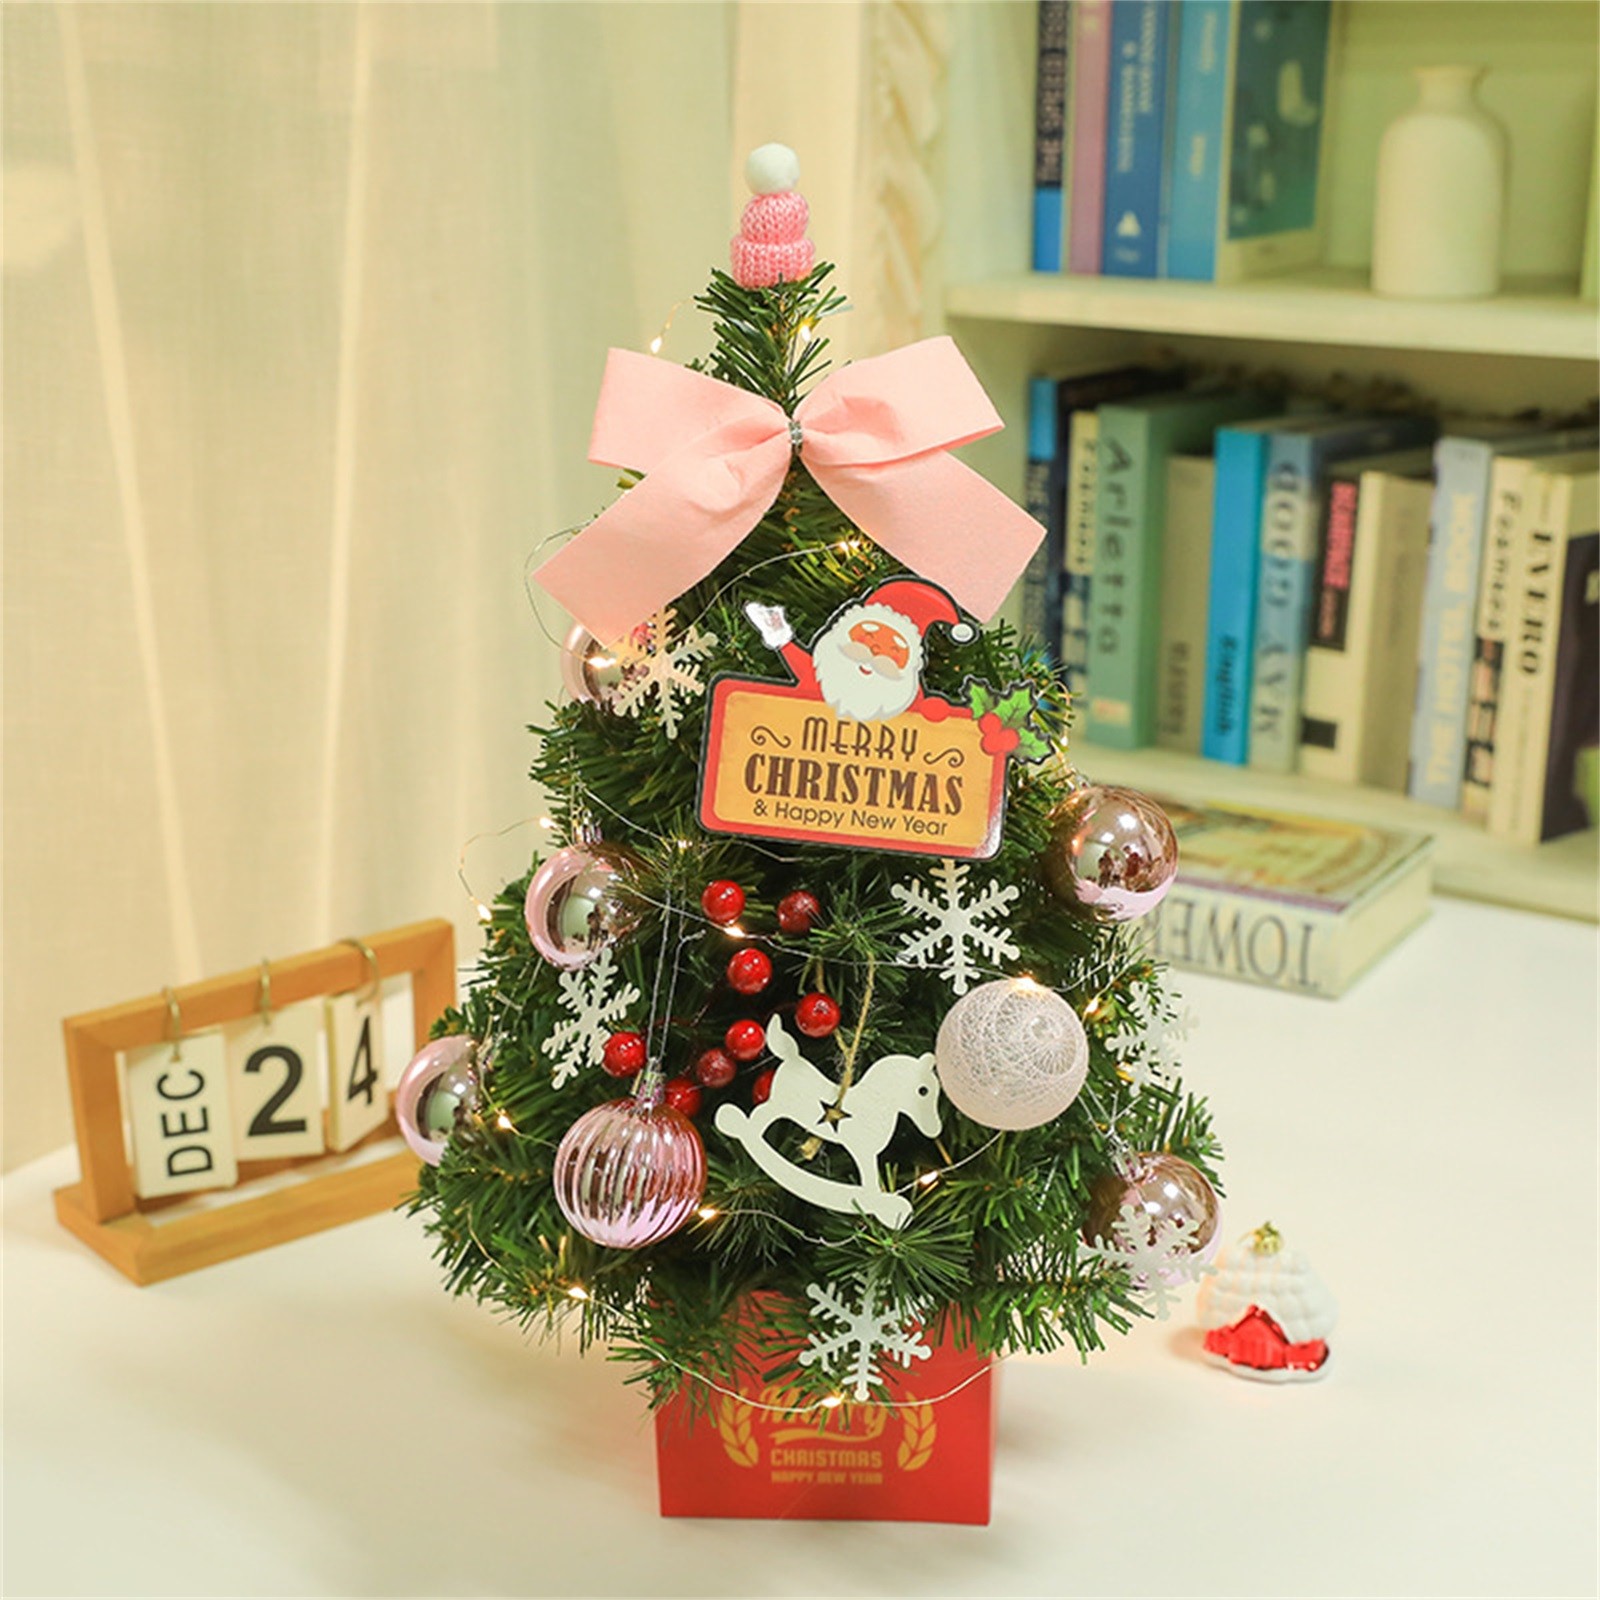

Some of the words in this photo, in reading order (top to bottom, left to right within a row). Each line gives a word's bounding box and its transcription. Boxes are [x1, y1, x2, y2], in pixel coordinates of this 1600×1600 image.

[802, 716, 918, 762] MERRY
[744, 752, 964, 816] CHRISTMAS
[753, 798, 768, 817] &
[774, 801, 845, 828] Happy
[850, 809, 897, 830] New
[902, 815, 948, 836] Year
[156, 1068, 214, 1178] DEC
[244, 1045, 308, 1138] 2
[347, 1015, 378, 1105] 4
[770, 1448, 883, 1468] CHRISTMAS
